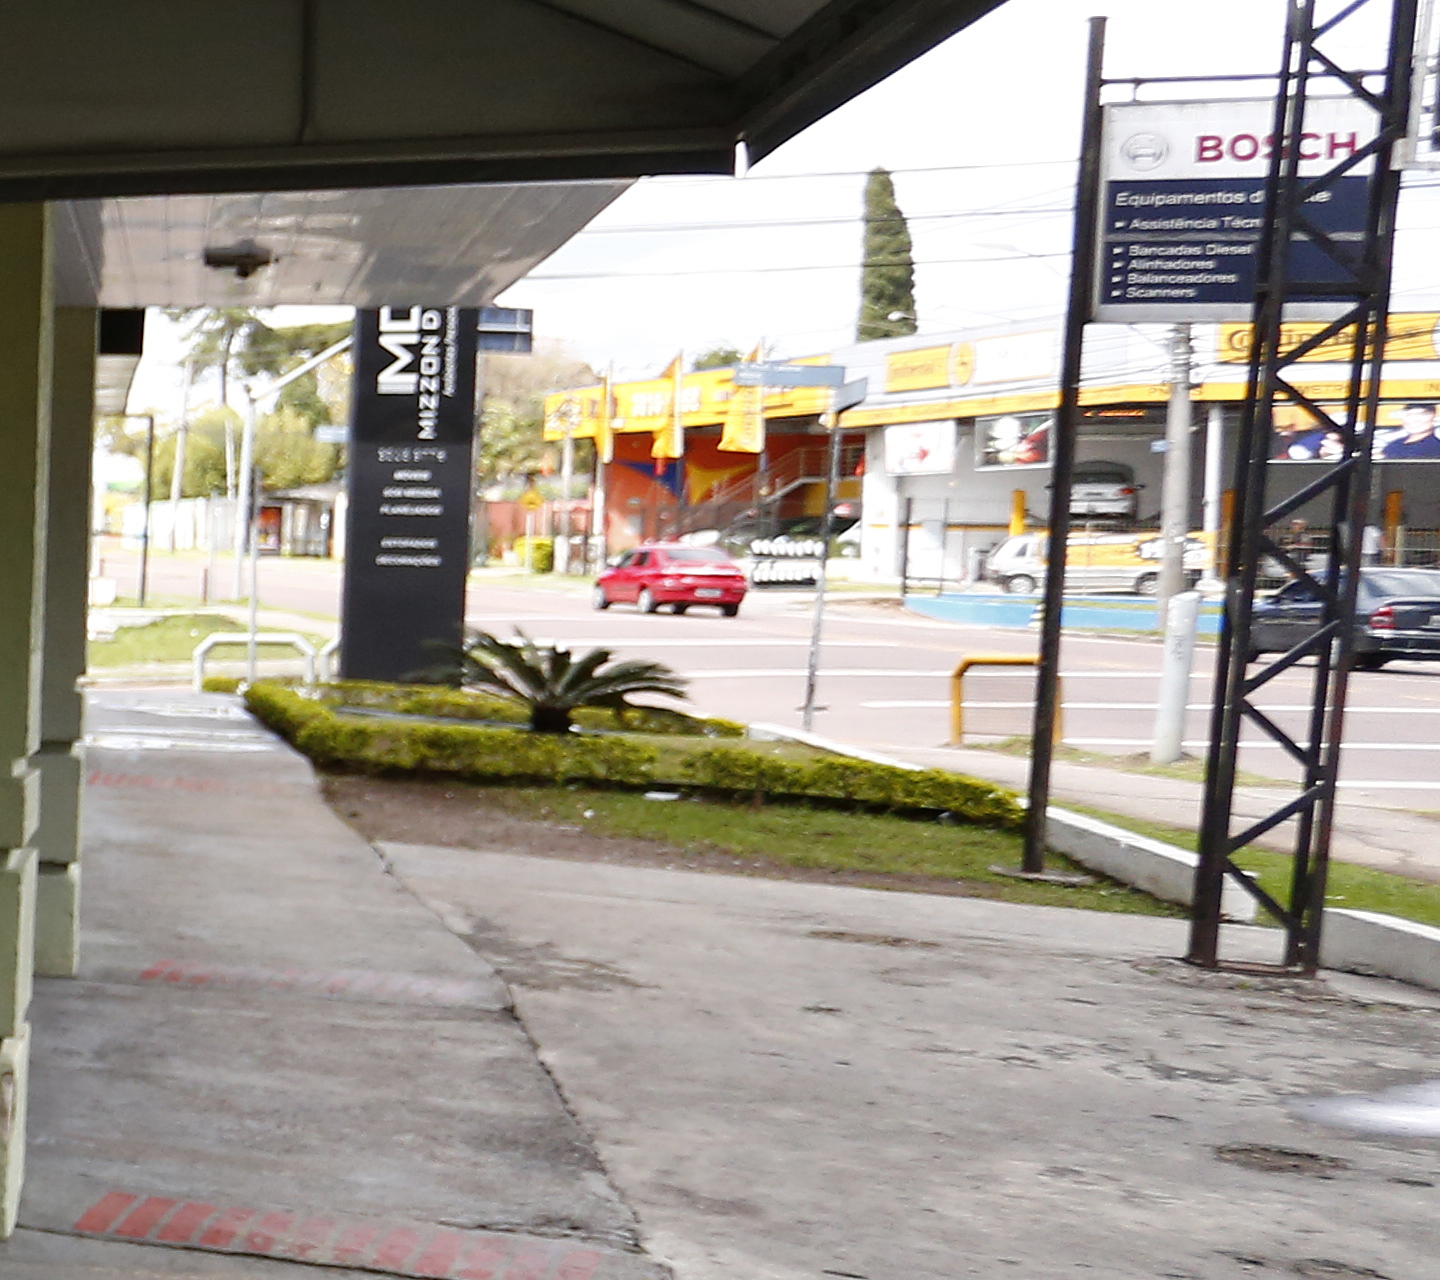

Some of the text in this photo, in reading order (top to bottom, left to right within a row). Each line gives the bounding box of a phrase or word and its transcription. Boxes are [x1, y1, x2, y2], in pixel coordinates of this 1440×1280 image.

[1115, 190, 1246, 208] Equipamentos
[1129, 244, 1255, 256] Bancadas Diesel
[1126, 287, 1198, 298] Scanners
